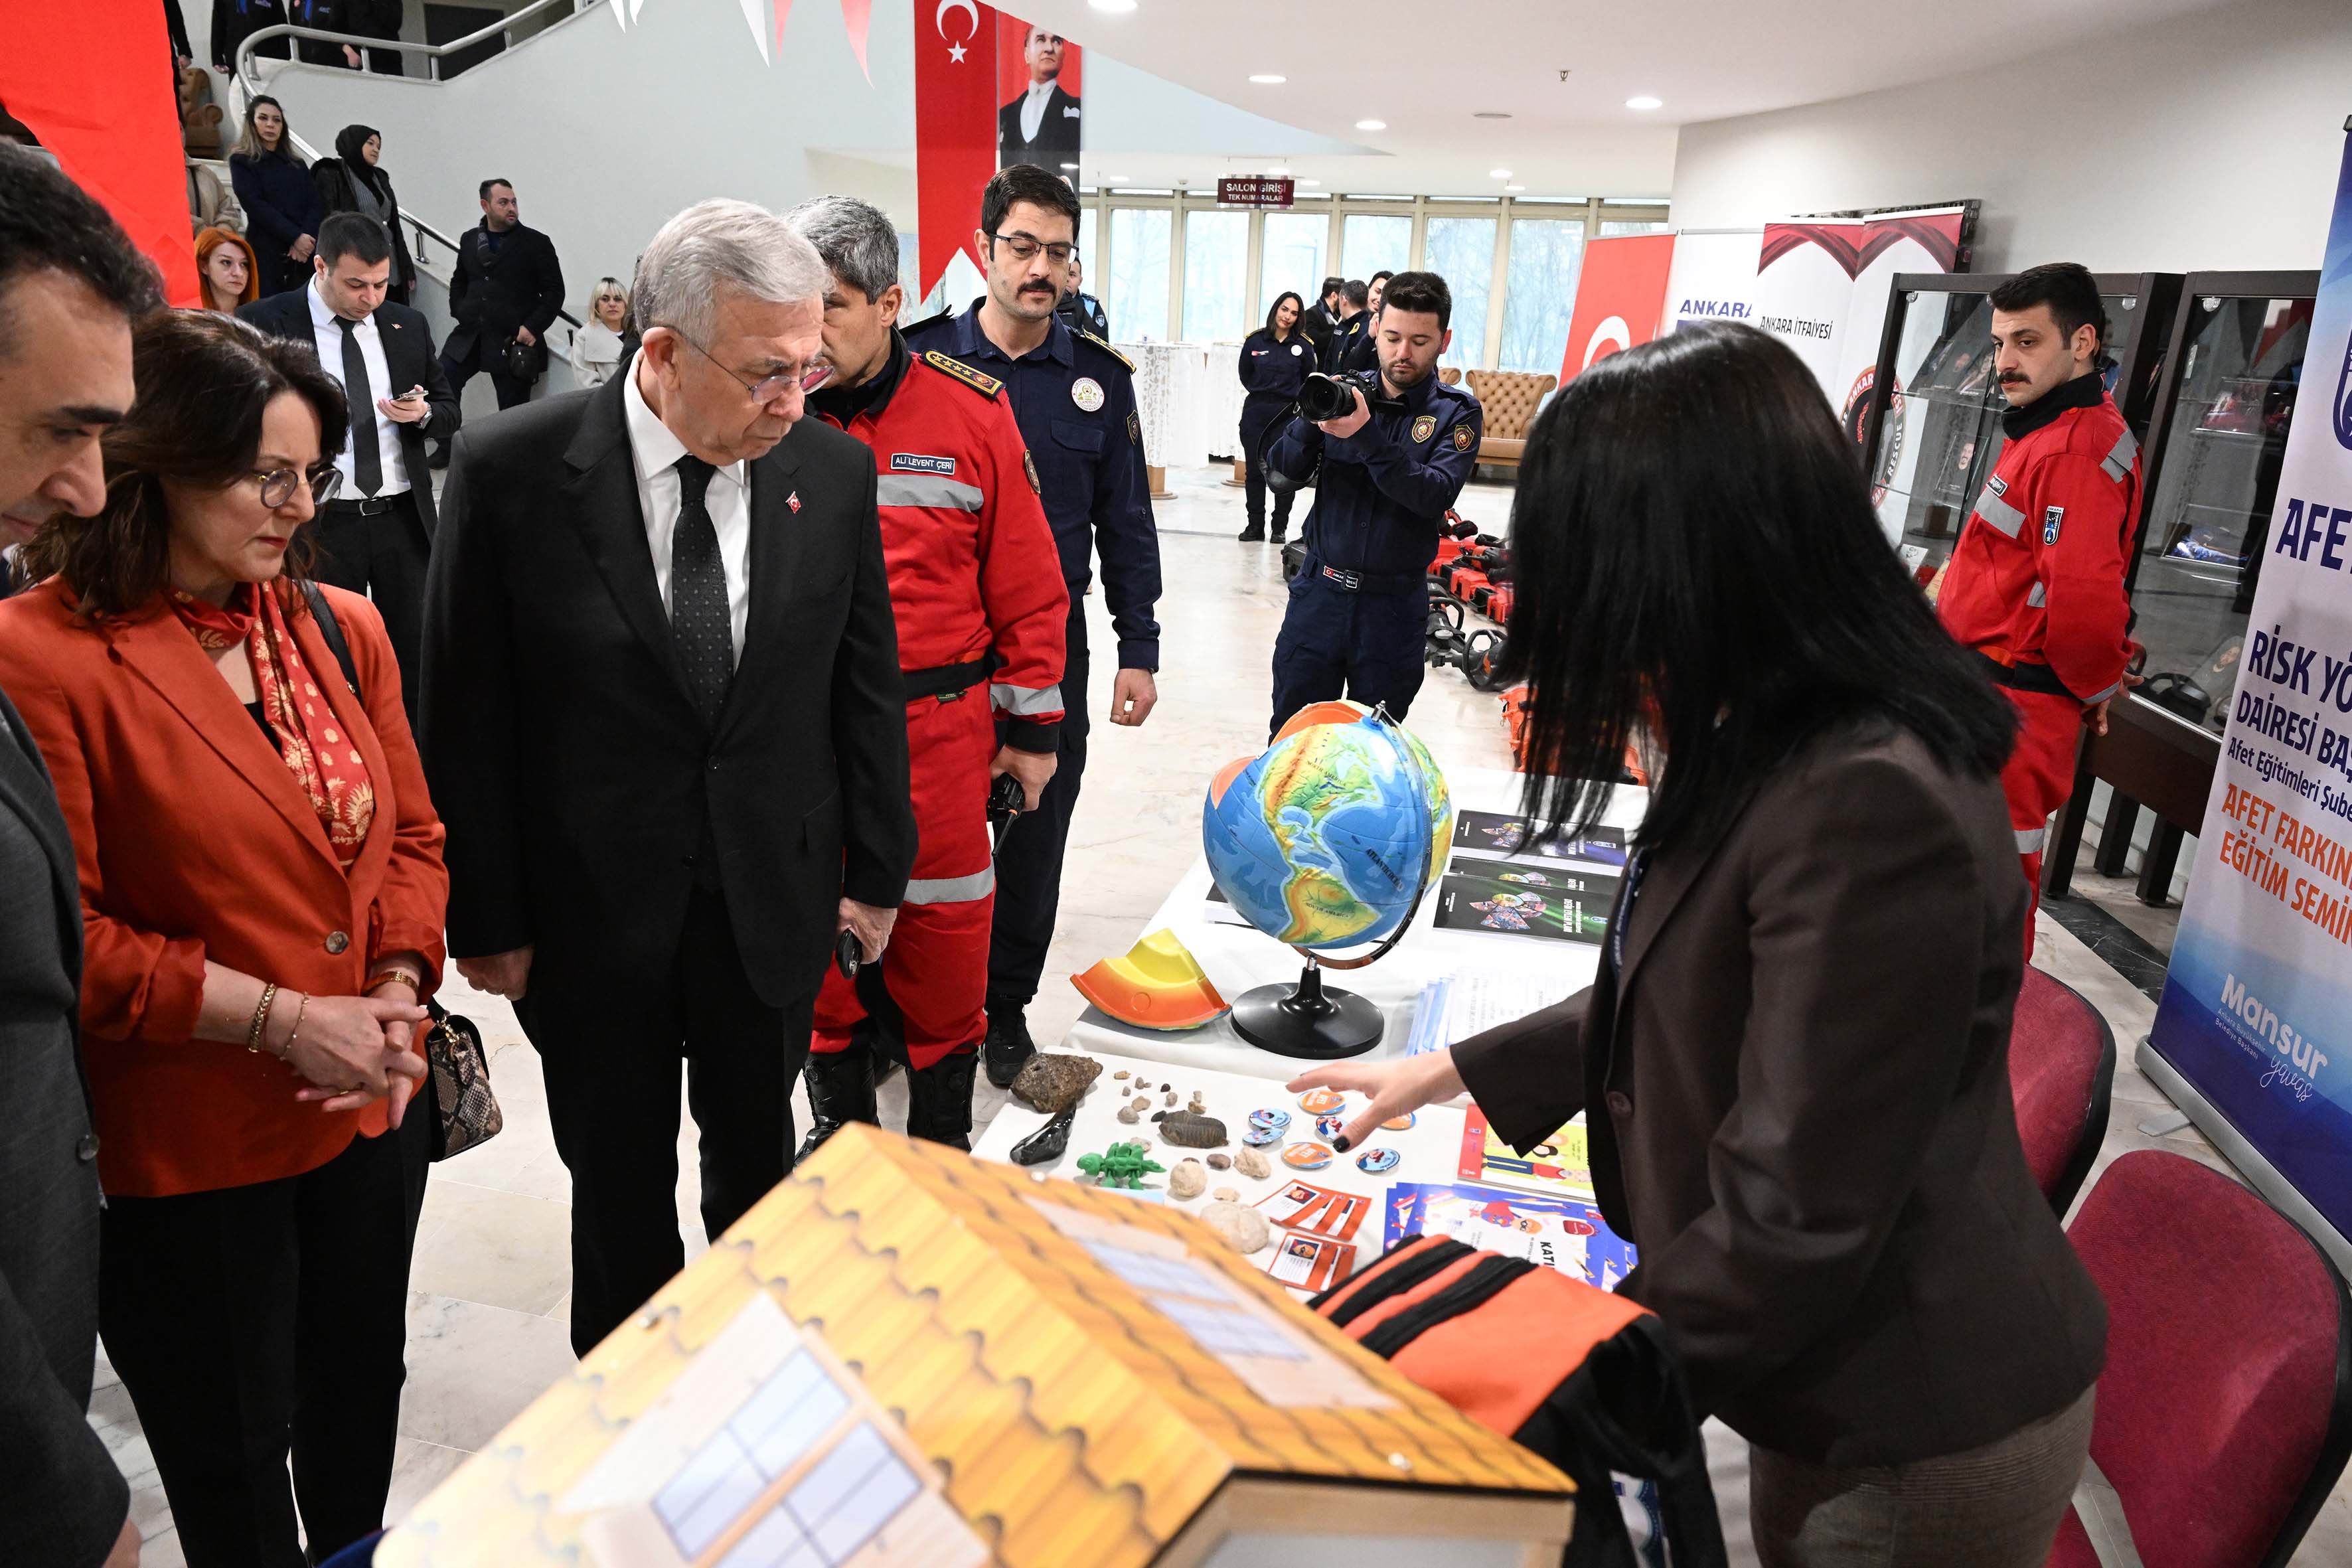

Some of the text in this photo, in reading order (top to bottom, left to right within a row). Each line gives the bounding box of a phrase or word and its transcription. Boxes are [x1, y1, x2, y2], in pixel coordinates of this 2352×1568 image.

[1226, 183, 1286, 194] SALON GİRİŞİ
[1760, 316, 1833, 339] ANKARA İTFAİYESİ
[1849, 372, 1874, 406] ANKAR
[908, 457, 935, 467] LEVENT
[936, 461, 953, 470] ÇERİ
[1887, 422, 1903, 477] RESCUE
[2276, 498, 2352, 574] AFE
[2248, 625, 2317, 696] RİSK
[2236, 690, 2319, 755] DAİRESİ
[2227, 737, 2255, 767] Afet
[2256, 750, 2321, 803] Eğitimleri
[2221, 783, 2276, 835] AFET
[2219, 829, 2289, 902] EĞİTİM
[2215, 1018, 2259, 1060] Belediye Başkanı
[2217, 1008, 2236, 1027] Ankara
[2221, 973, 2328, 1080] Mansur
[1540, 1241, 1556, 1269] KATI
